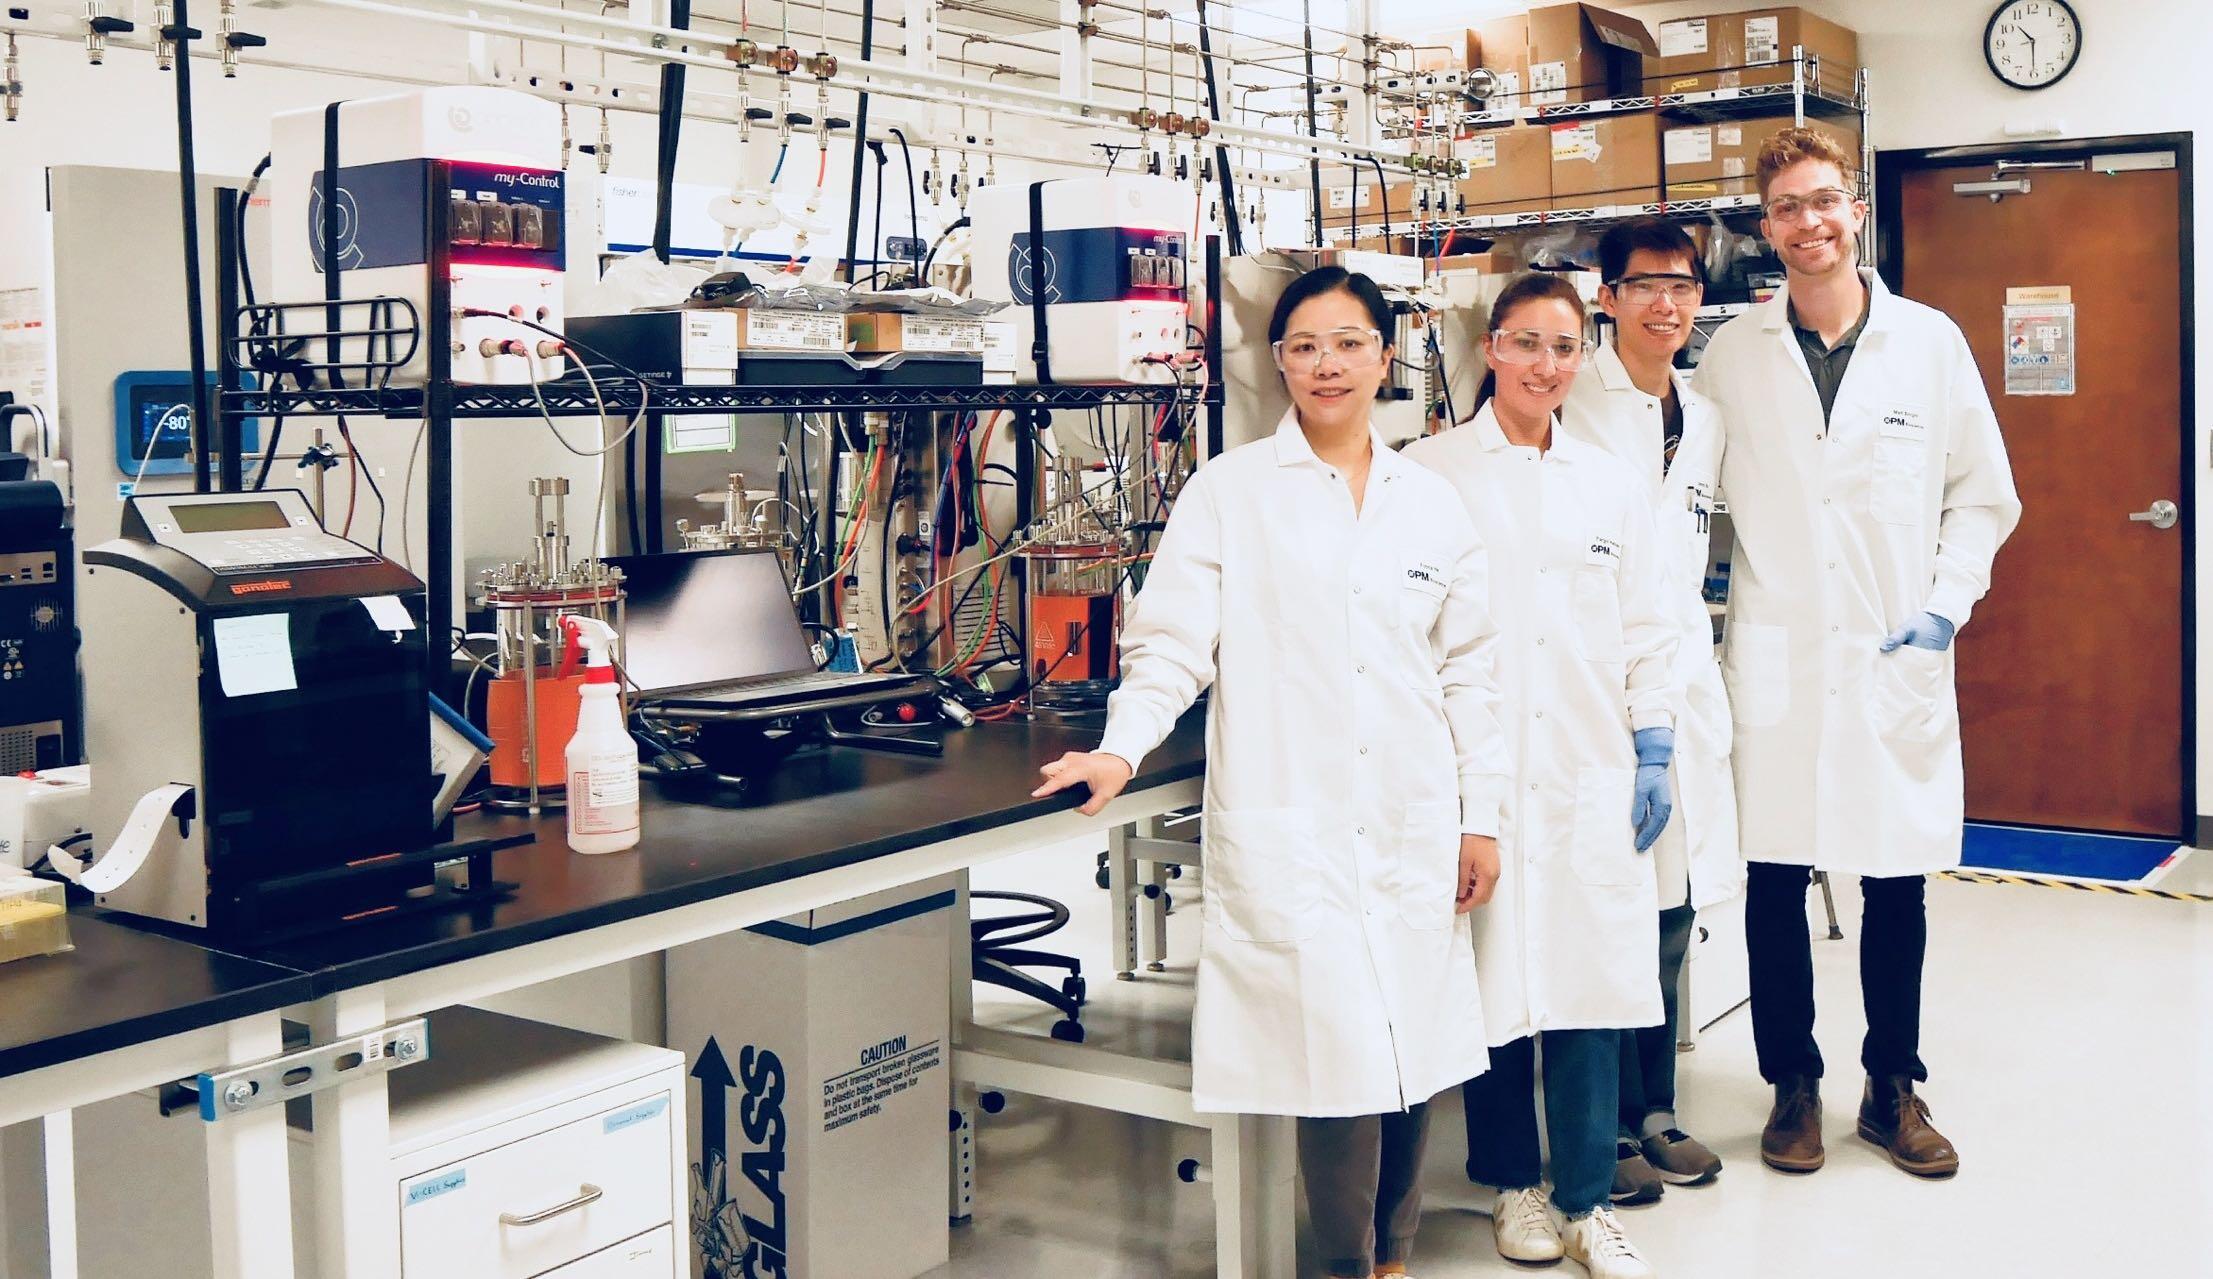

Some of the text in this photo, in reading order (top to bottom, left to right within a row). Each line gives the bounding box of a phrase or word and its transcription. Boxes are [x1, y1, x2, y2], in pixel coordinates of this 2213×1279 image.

[2014, 9, 2022, 20] 11
[2027, 4, 2039, 15] 12
[2057, 17, 2065, 27] 2
[2001, 24, 2015, 34] 10
[2063, 33, 2071, 44] 3
[1996, 40, 2005, 50] 9
[2002, 56, 2011, 65] 8
[2057, 51, 2064, 61] 4
[2015, 65, 2022, 76] 7
[2030, 69, 2038, 78] 6
[2046, 63, 2054, 73] 5
[494, 172, 560, 189] my-Control
[1883, 416, 1905, 426] OPM
[1407, 569, 1430, 582] OPM
[861, 1035, 906, 1066] CAUTION
[824, 1046, 939, 1096] Do not transport broken glassware
[824, 1057, 940, 1107] in plastic bags. Dispose of contents
[824, 1077, 918, 1120] and box at the same time for
[824, 1103, 882, 1132] maximum safety.
[740, 1044, 786, 1279] GLASS
